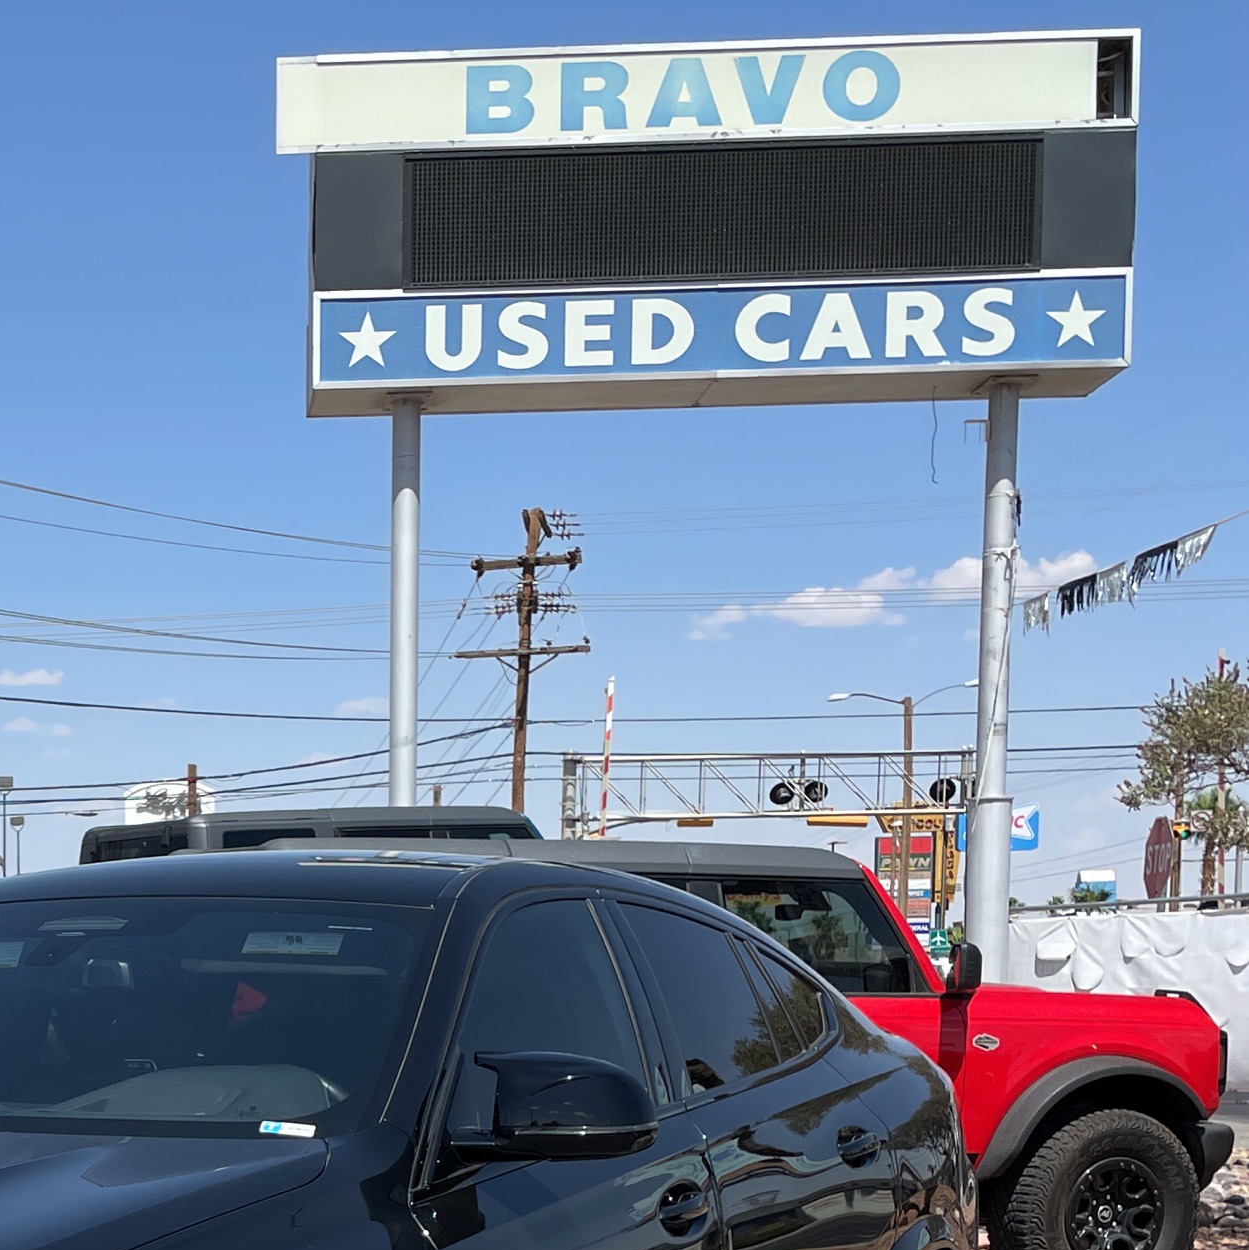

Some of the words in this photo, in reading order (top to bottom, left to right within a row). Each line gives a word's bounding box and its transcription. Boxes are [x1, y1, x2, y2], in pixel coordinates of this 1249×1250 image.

[465, 50, 901, 135] BRAVO
[425, 298, 695, 372] USED
[735, 287, 1015, 361] CARS
[1146, 842, 1172, 875] STOP
